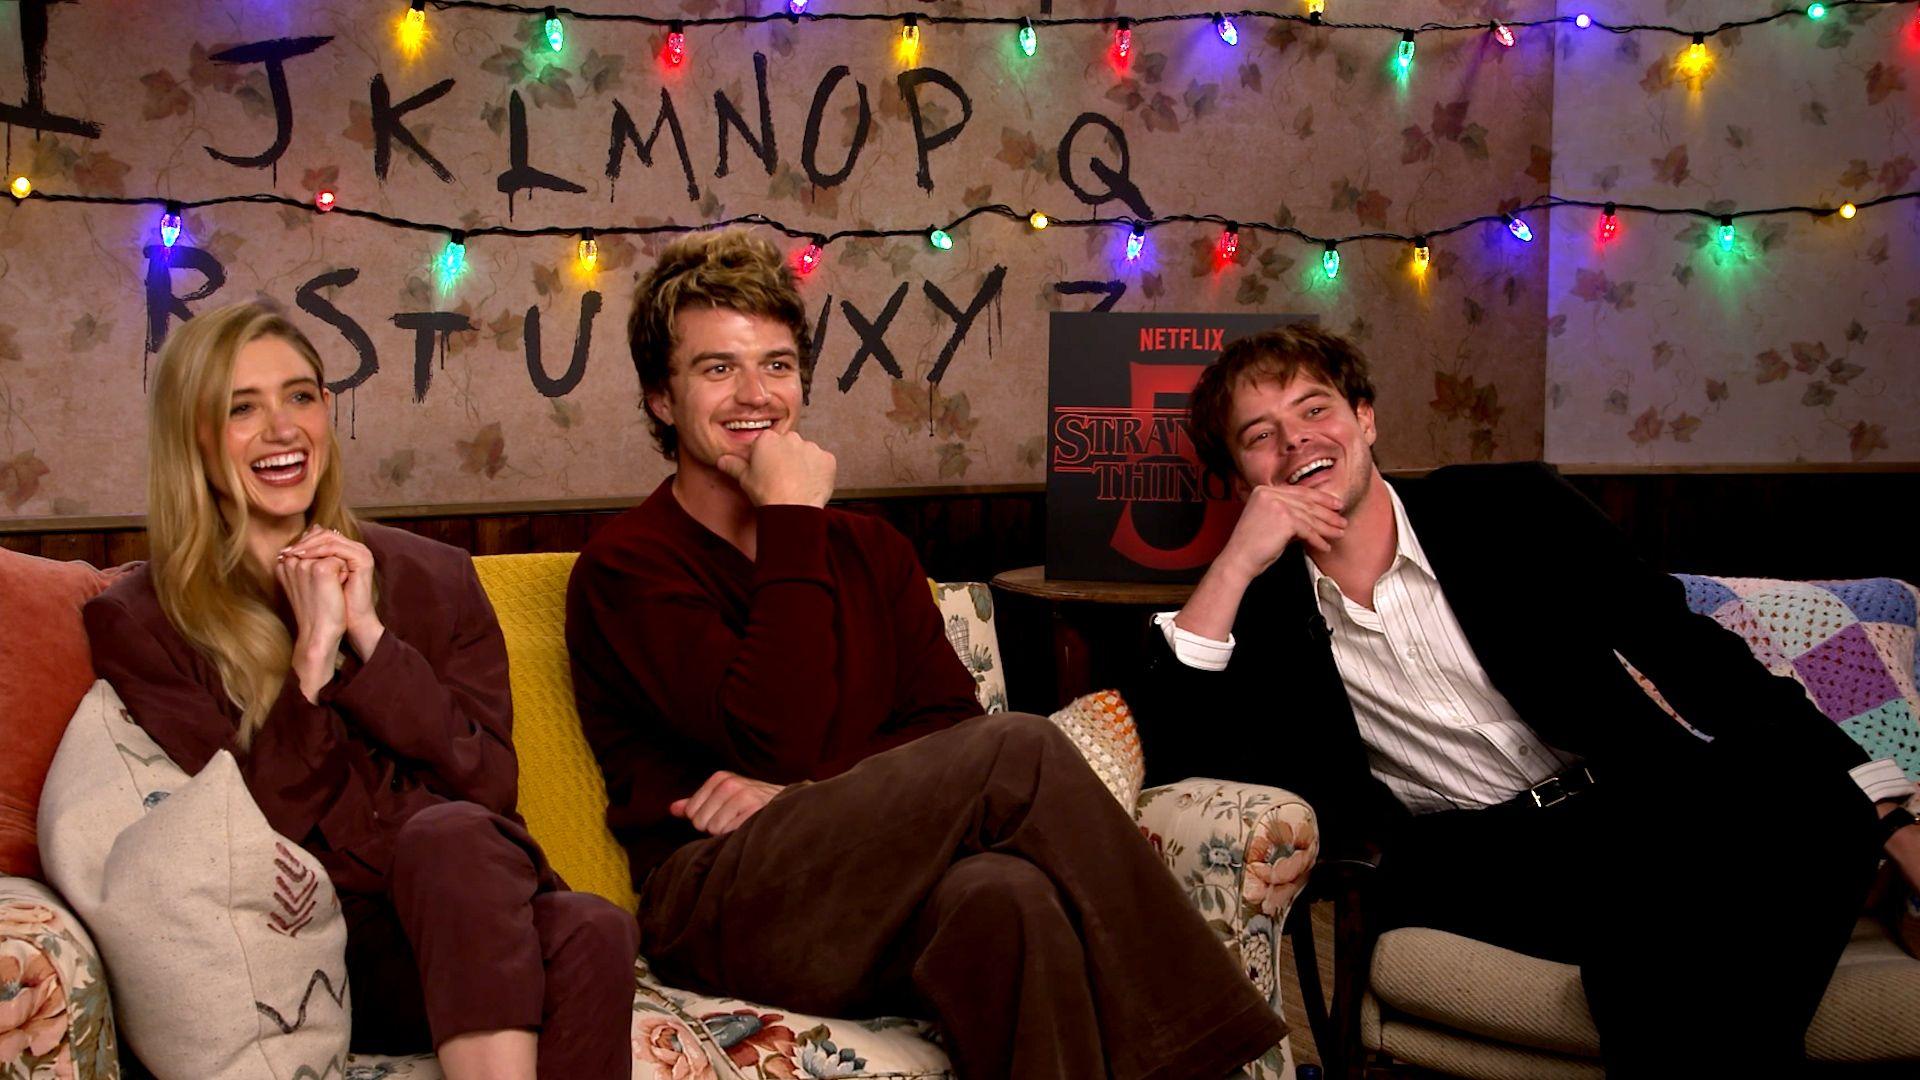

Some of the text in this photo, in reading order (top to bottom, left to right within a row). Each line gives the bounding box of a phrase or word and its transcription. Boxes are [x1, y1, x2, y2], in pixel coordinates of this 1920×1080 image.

[203, 36, 334, 170] J
[370, 73, 456, 184] K
[497, 90, 587, 198] L
[605, 87, 700, 202] M
[714, 52, 777, 178] N
[801, 65, 871, 190] O
[898, 67, 973, 195] P
[1058, 112, 1154, 220] Q
[143, 245, 227, 354] R
[295, 267, 380, 395] S
[388, 311, 480, 404] T
[524, 291, 602, 398] U
[837, 281, 909, 394] X
[923, 265, 1006, 384] Y
[1140, 328, 1225, 352] NETFLIX
[1054, 413, 1196, 465] STRAN
[1094, 462, 1232, 502] THING
[1109, 361, 1246, 570] 5
